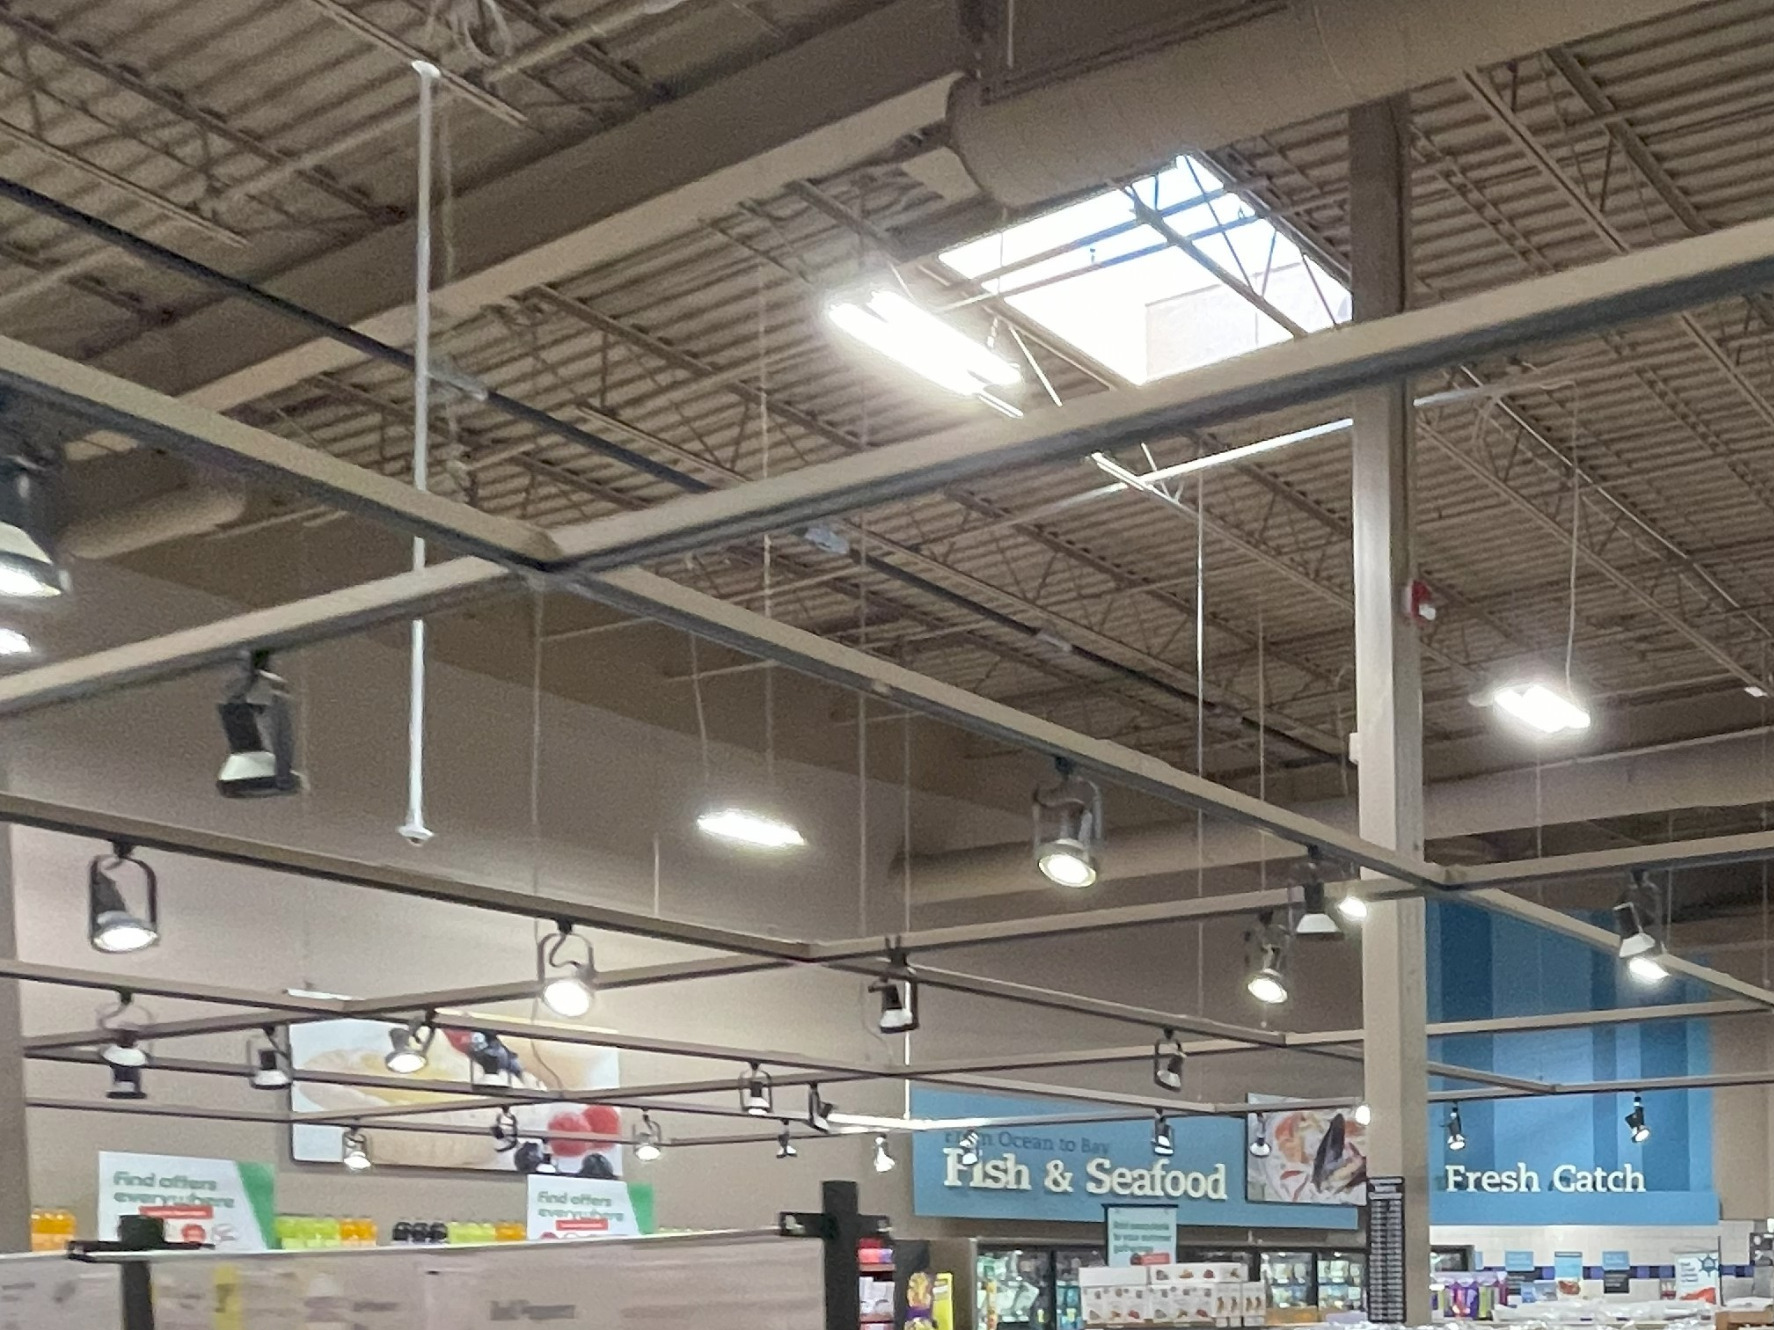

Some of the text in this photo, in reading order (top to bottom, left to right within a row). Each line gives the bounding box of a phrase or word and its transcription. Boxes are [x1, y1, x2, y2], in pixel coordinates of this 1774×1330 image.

[998, 1131, 1054, 1150] Ocean
[1060, 1136, 1077, 1153] to
[1044, 1158, 1074, 1193] &
[1086, 1157, 1228, 1200] Seafood
[1445, 1162, 1646, 1193] Fresh Catch
